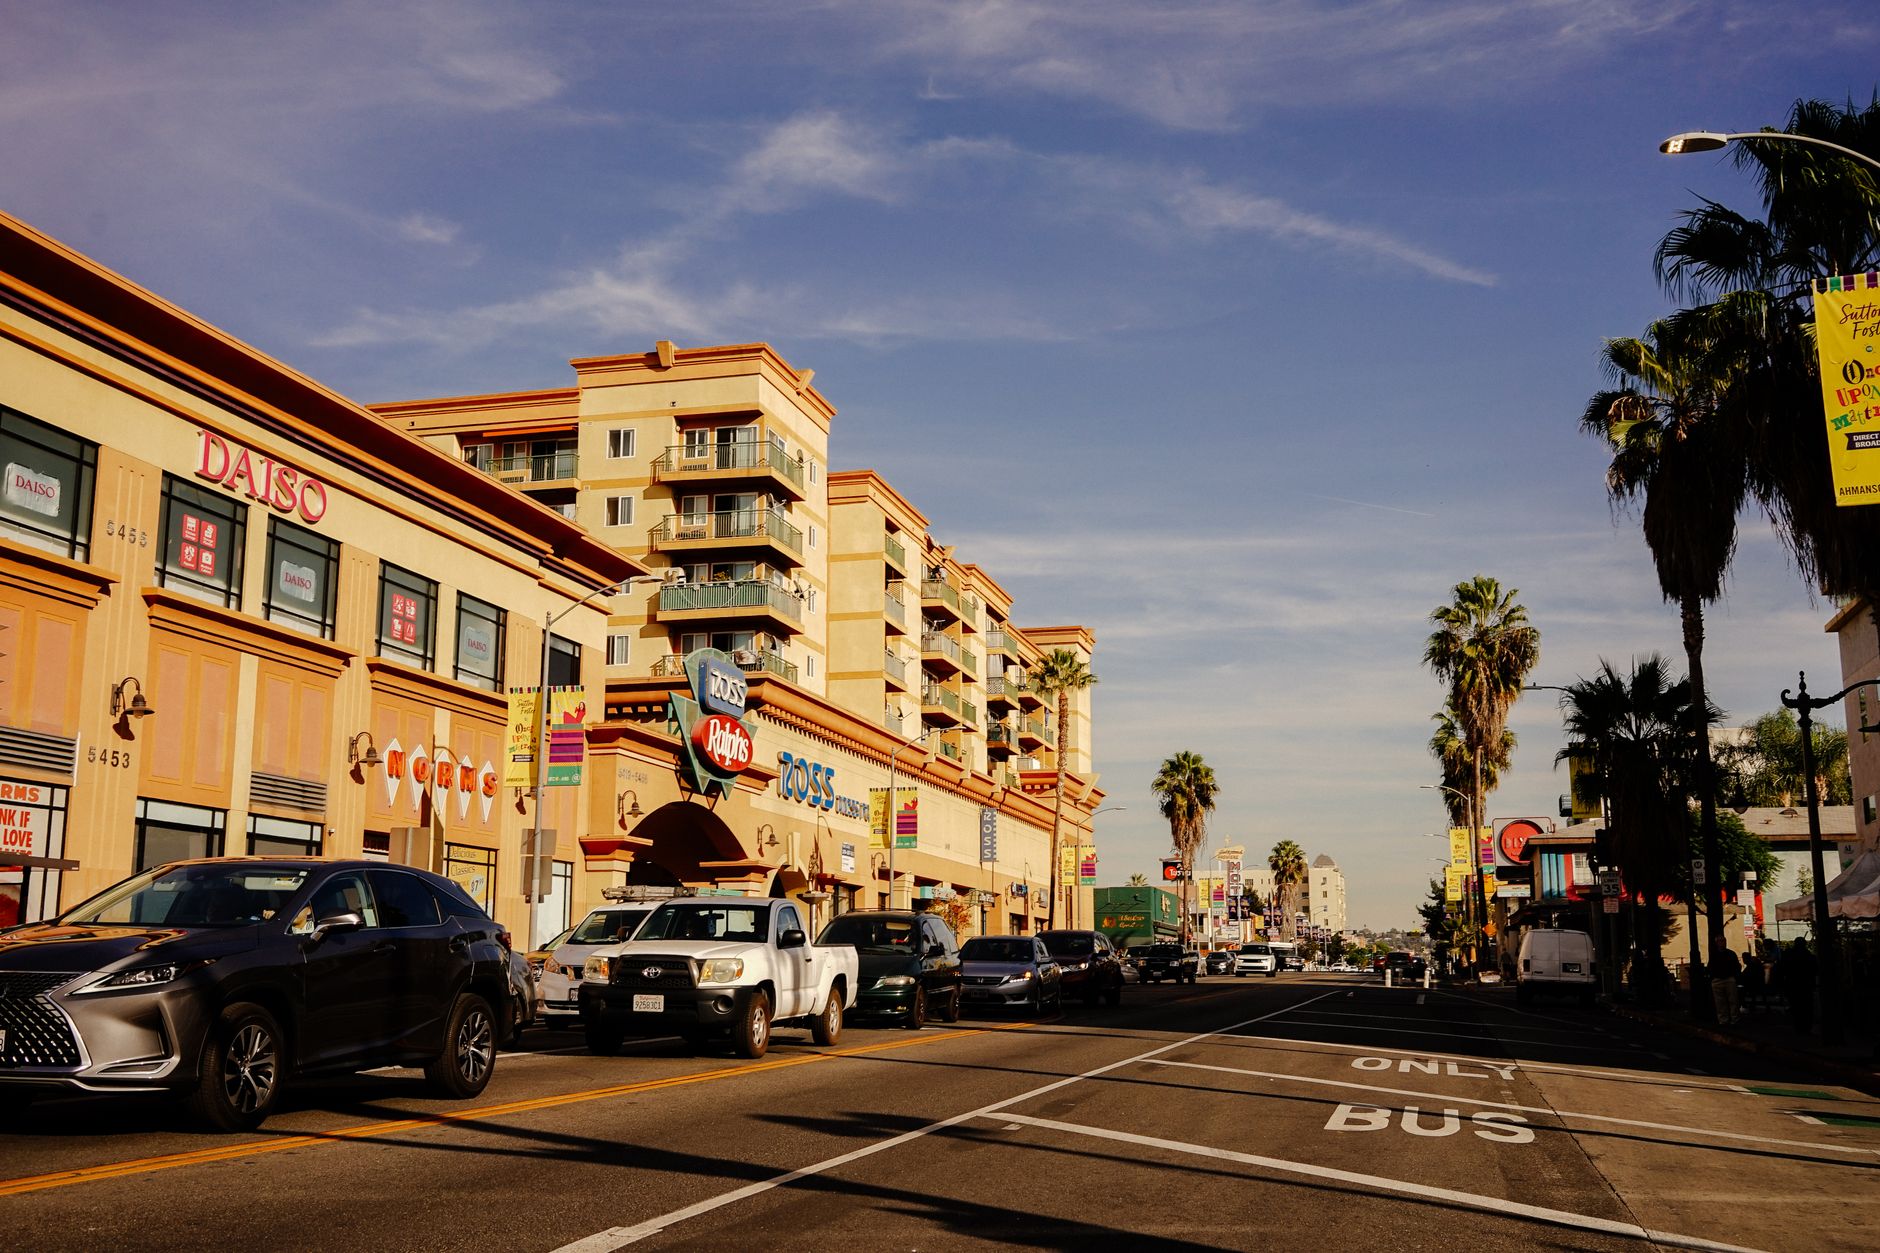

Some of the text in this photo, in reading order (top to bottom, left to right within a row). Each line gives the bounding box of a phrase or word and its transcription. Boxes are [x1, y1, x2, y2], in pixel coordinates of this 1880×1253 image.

[1853, 433, 1879, 442] DIRECT
[15, 475, 56, 499] DAISO
[194, 430, 327, 523] DAISO
[284, 572, 312, 590] DAISO
[467, 637, 487, 653] DAISO
[711, 668, 746, 708] ROSS
[707, 718, 749, 767] Ralphs
[88, 746, 130, 769] 5453
[388, 749, 498, 797] NORMS
[777, 751, 836, 812] ROSS
[19, 810, 31, 828] IF
[3, 828, 33, 848] LOVE
[983, 811, 993, 859] ROSS
[450, 864, 476, 877] Classics
[1603, 884, 1619, 894] 35
[1351, 1057, 1519, 1081] ONLY
[1324, 1103, 1535, 1143] BUS
